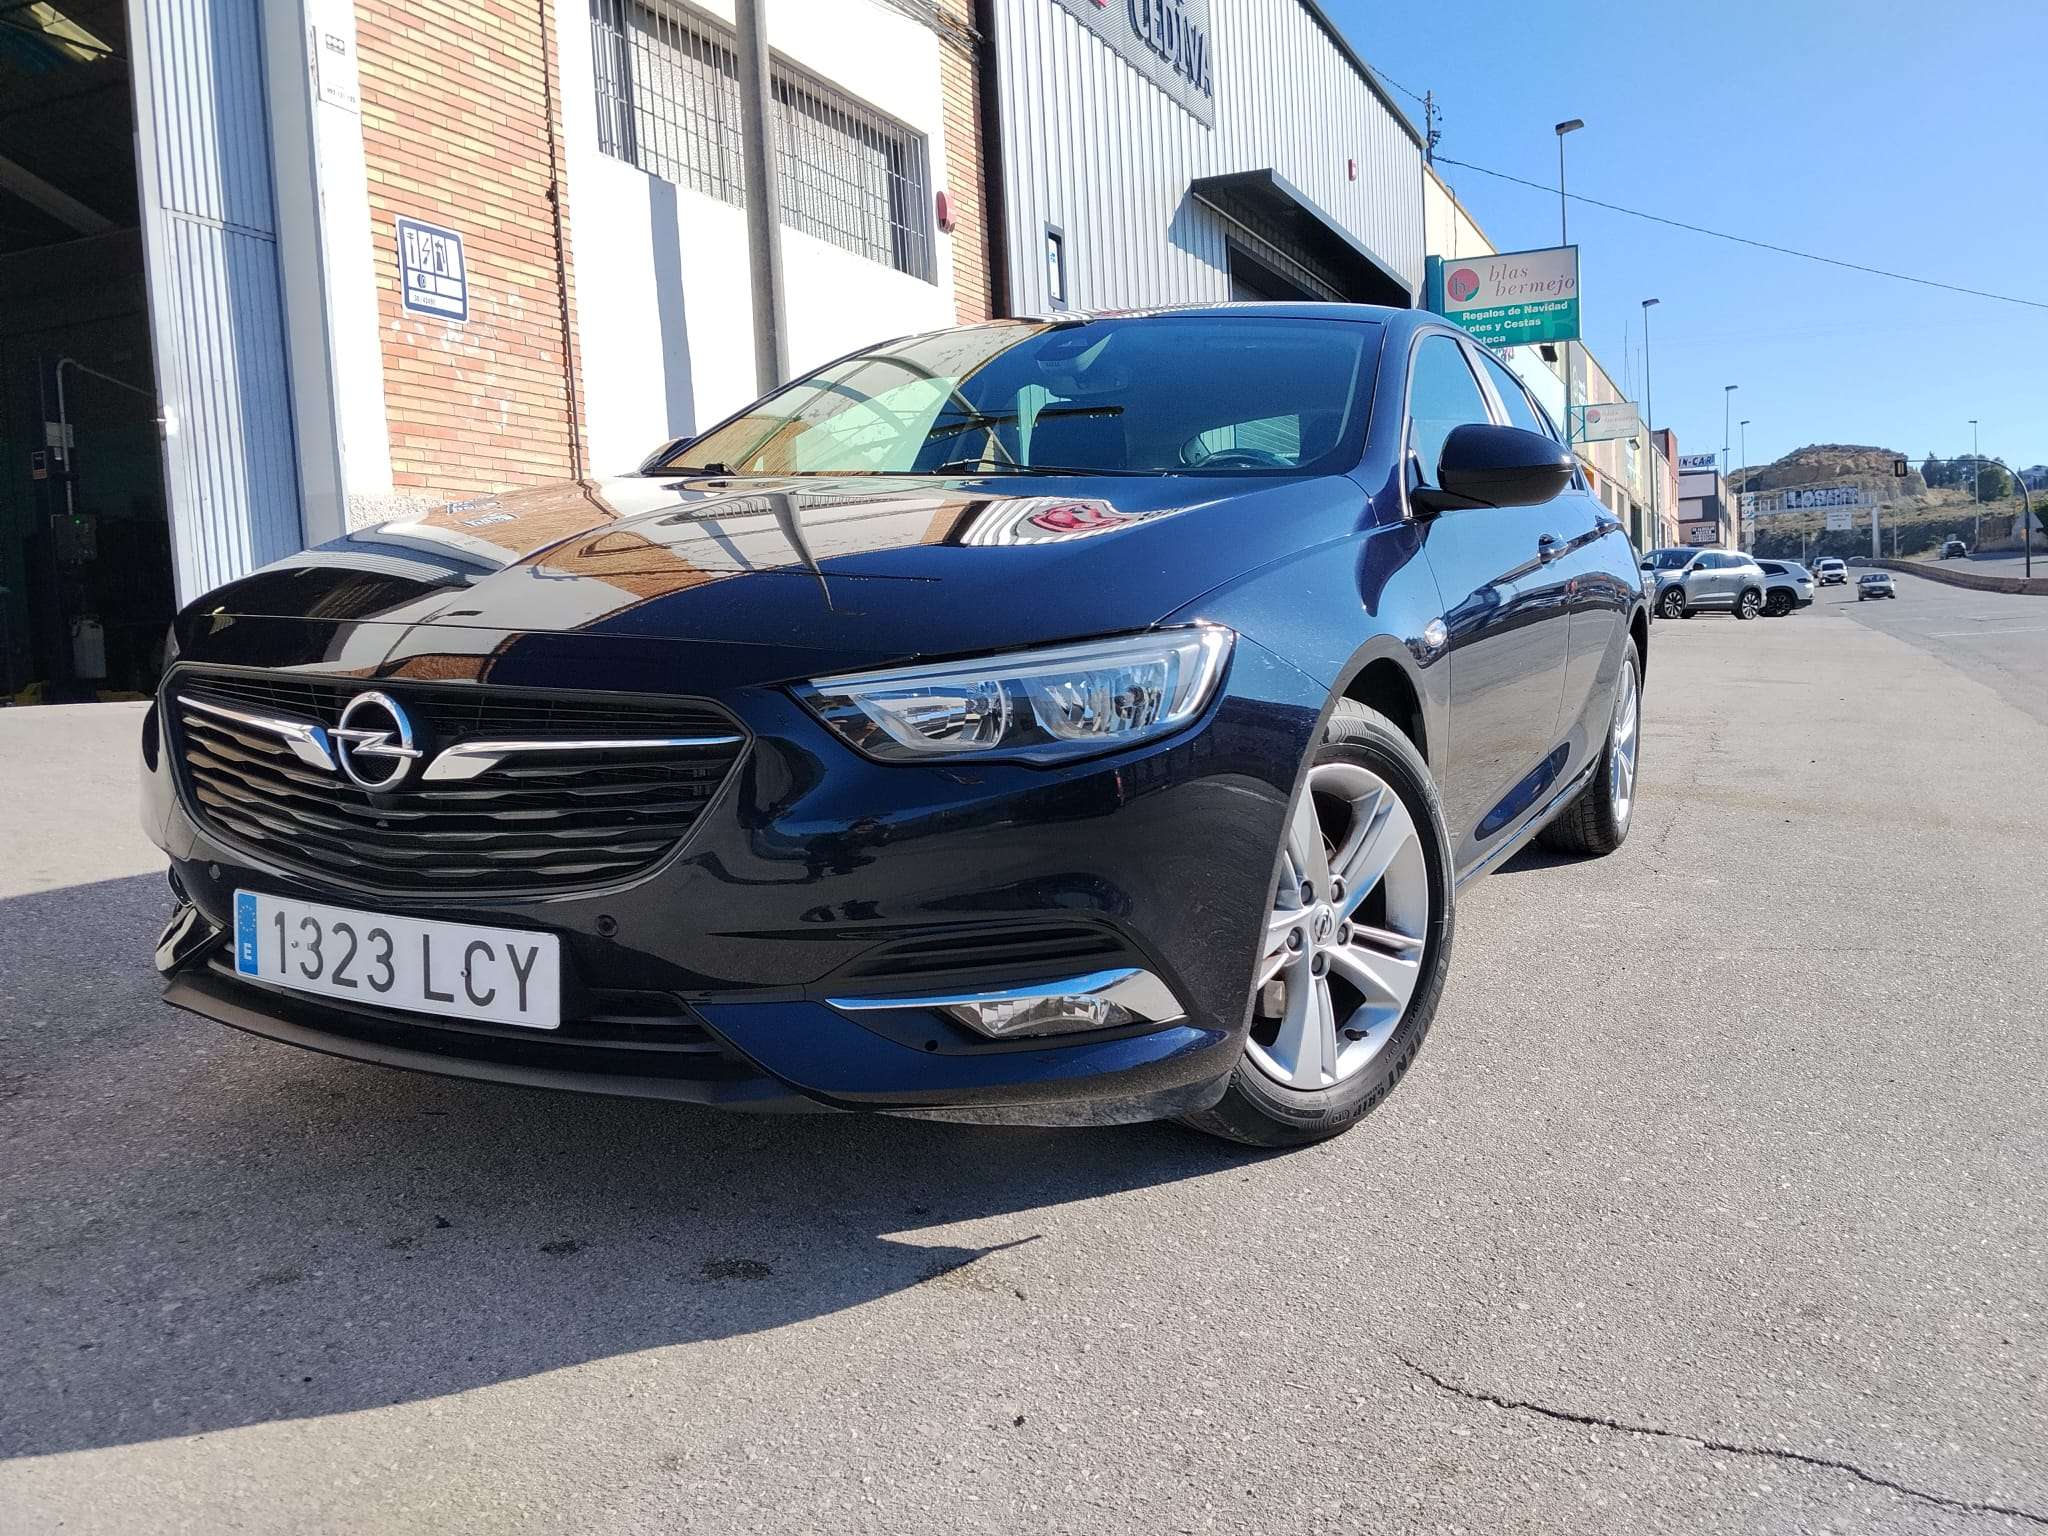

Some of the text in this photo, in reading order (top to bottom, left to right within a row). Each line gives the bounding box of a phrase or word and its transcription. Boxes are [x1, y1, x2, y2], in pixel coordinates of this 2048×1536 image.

[1489, 263, 1529, 282] blas
[1495, 275, 1575, 297] bermejo
[1462, 301, 1569, 321] Regalos de Navidad
[1495, 321, 1502, 332] y
[1503, 317, 1542, 329] Cestas
[243, 941, 252, 960] E
[274, 911, 540, 1013] 1323 LCY
